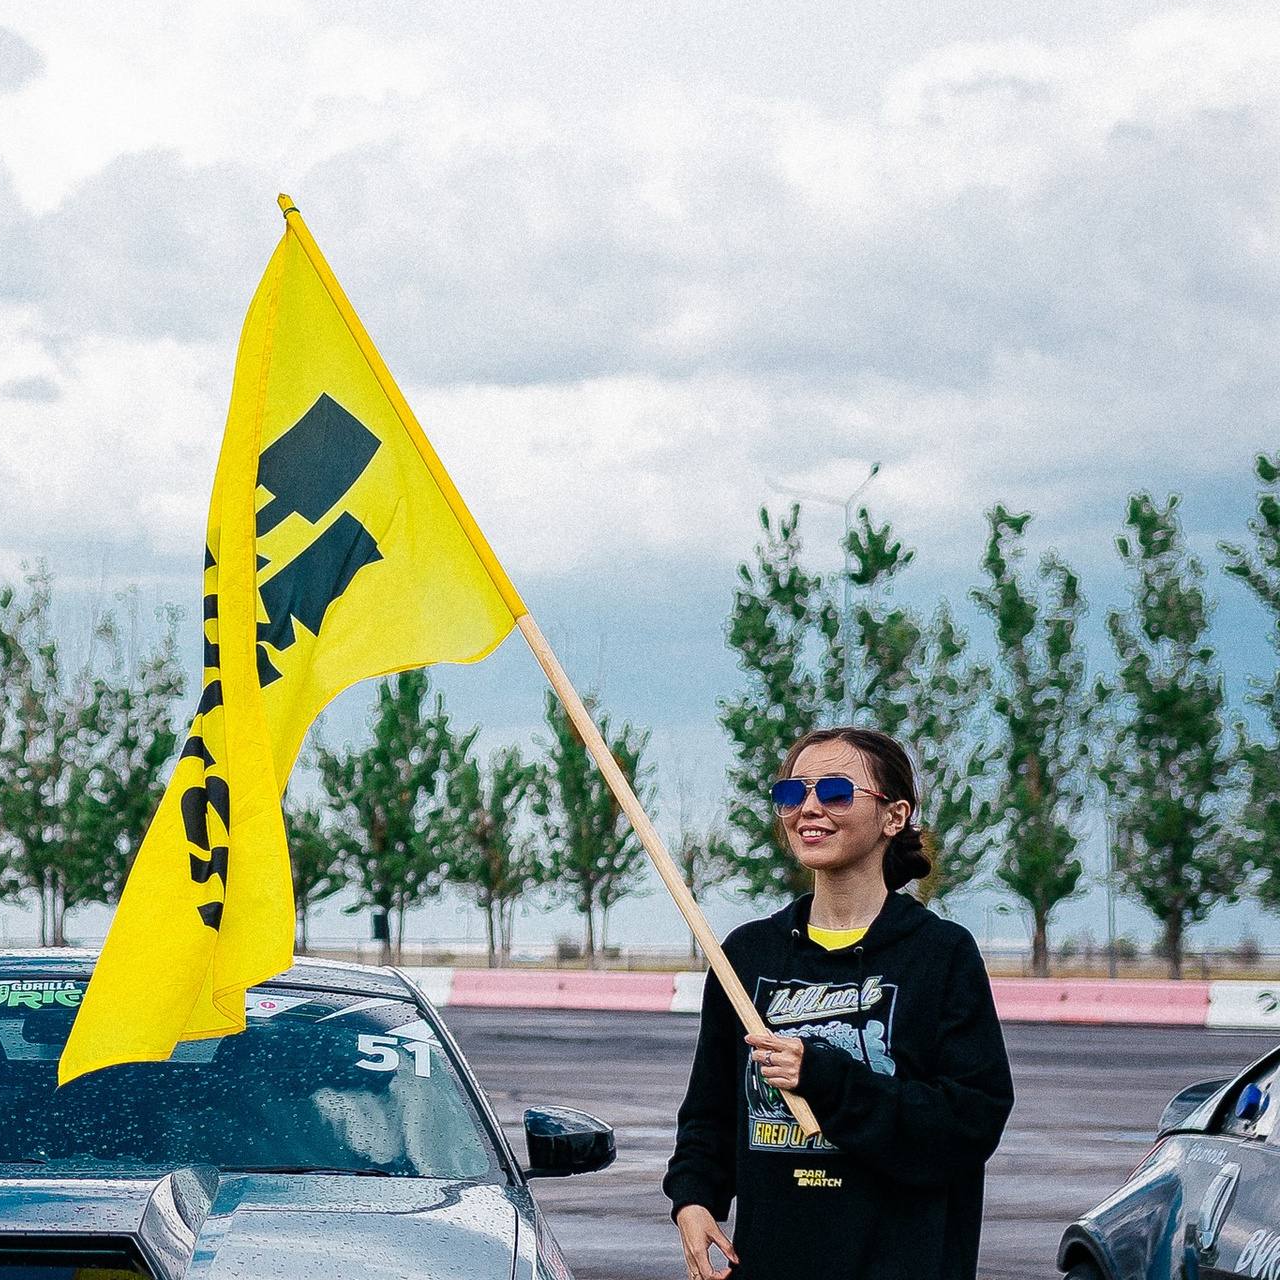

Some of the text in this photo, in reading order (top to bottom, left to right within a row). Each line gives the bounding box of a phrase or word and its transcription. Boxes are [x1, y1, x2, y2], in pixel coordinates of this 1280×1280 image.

[11, 982, 75, 991] GORILLA
[355, 1034, 431, 1077] 51
[754, 1122, 789, 1145] FIRED
[793, 1169, 826, 1178] PARI
[798, 1178, 842, 1187] MATCH
